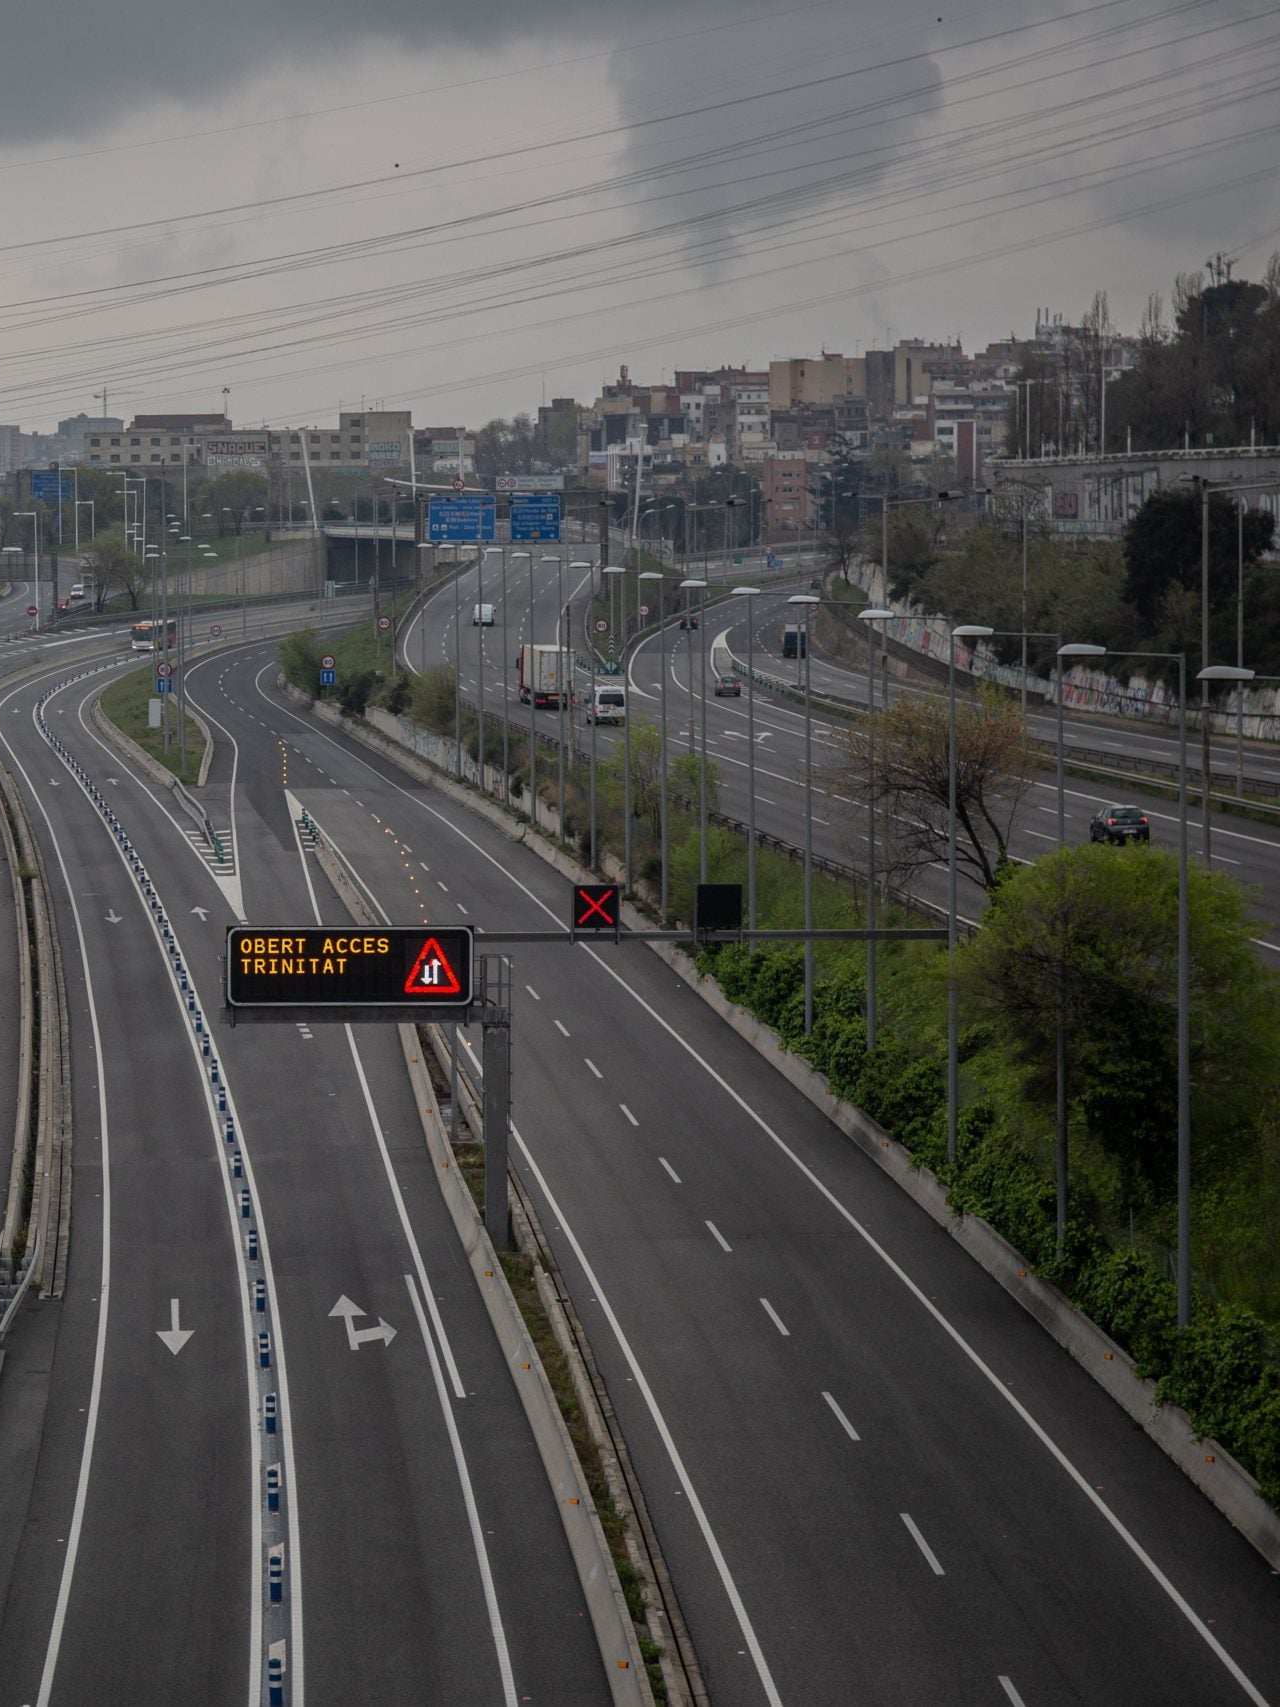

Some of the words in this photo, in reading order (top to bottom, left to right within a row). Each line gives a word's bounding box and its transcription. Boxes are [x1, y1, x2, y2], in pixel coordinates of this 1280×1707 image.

[241, 938, 307, 954] OBERT
[322, 938, 389, 954] ACCES
[241, 959, 348, 975] TRINITAT
